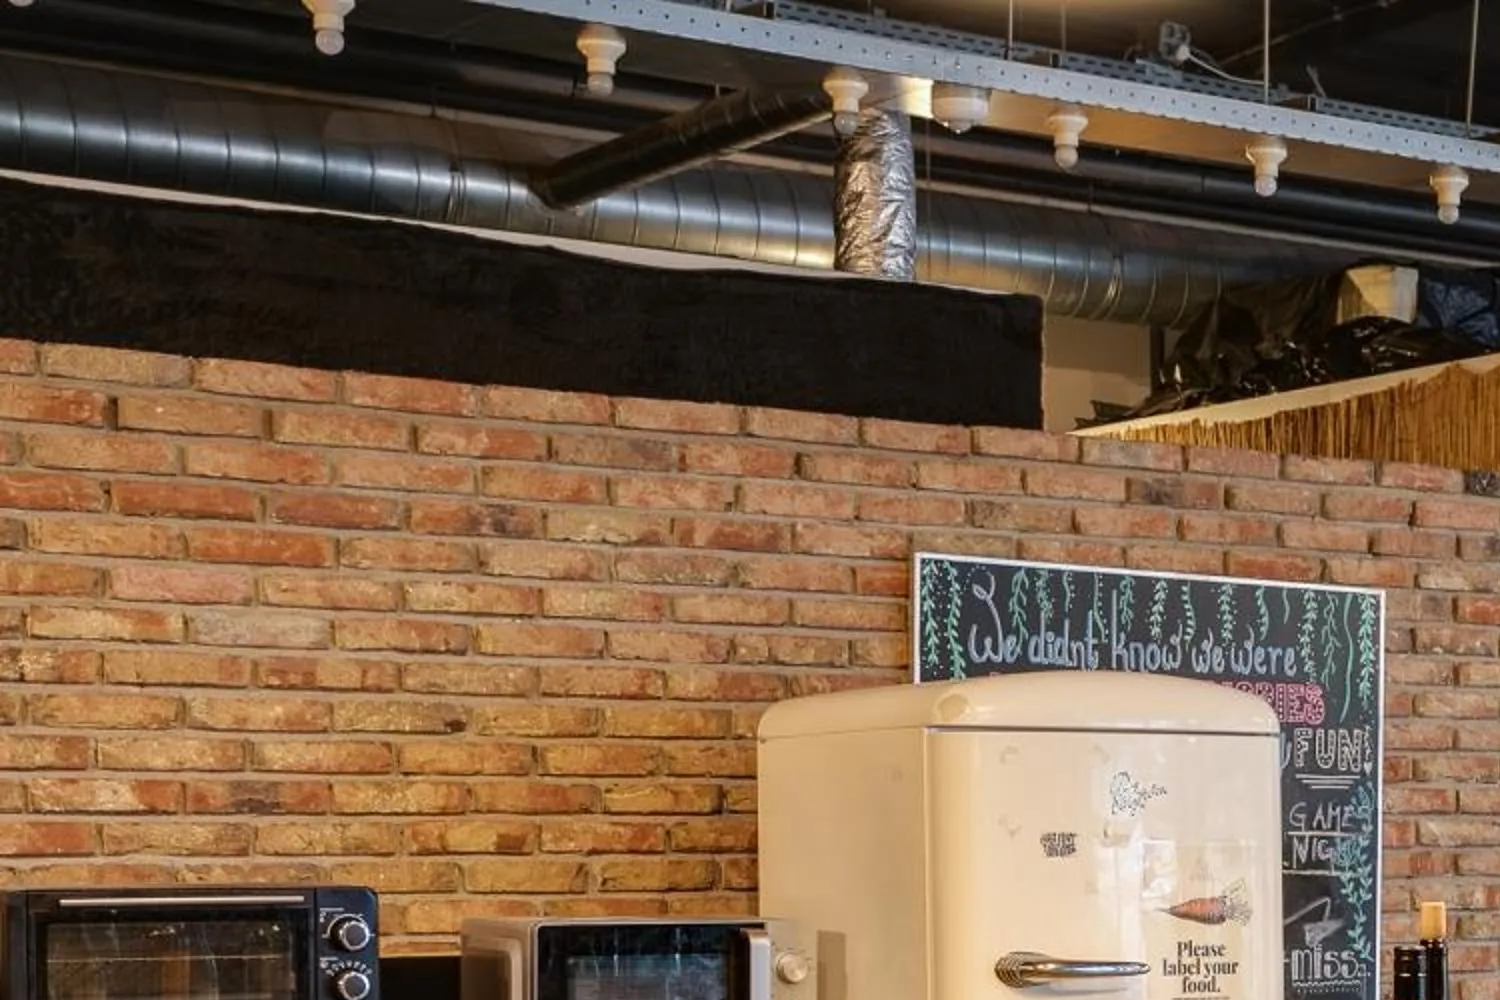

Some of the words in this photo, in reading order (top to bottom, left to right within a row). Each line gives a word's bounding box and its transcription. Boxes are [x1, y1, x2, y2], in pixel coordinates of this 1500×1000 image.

[968, 571, 1018, 664] We
[1231, 624, 1297, 677] were
[1177, 939, 1228, 958] Please
[1162, 957, 1201, 976] label
[1203, 961, 1239, 979] your
[1182, 975, 1221, 994] food.
